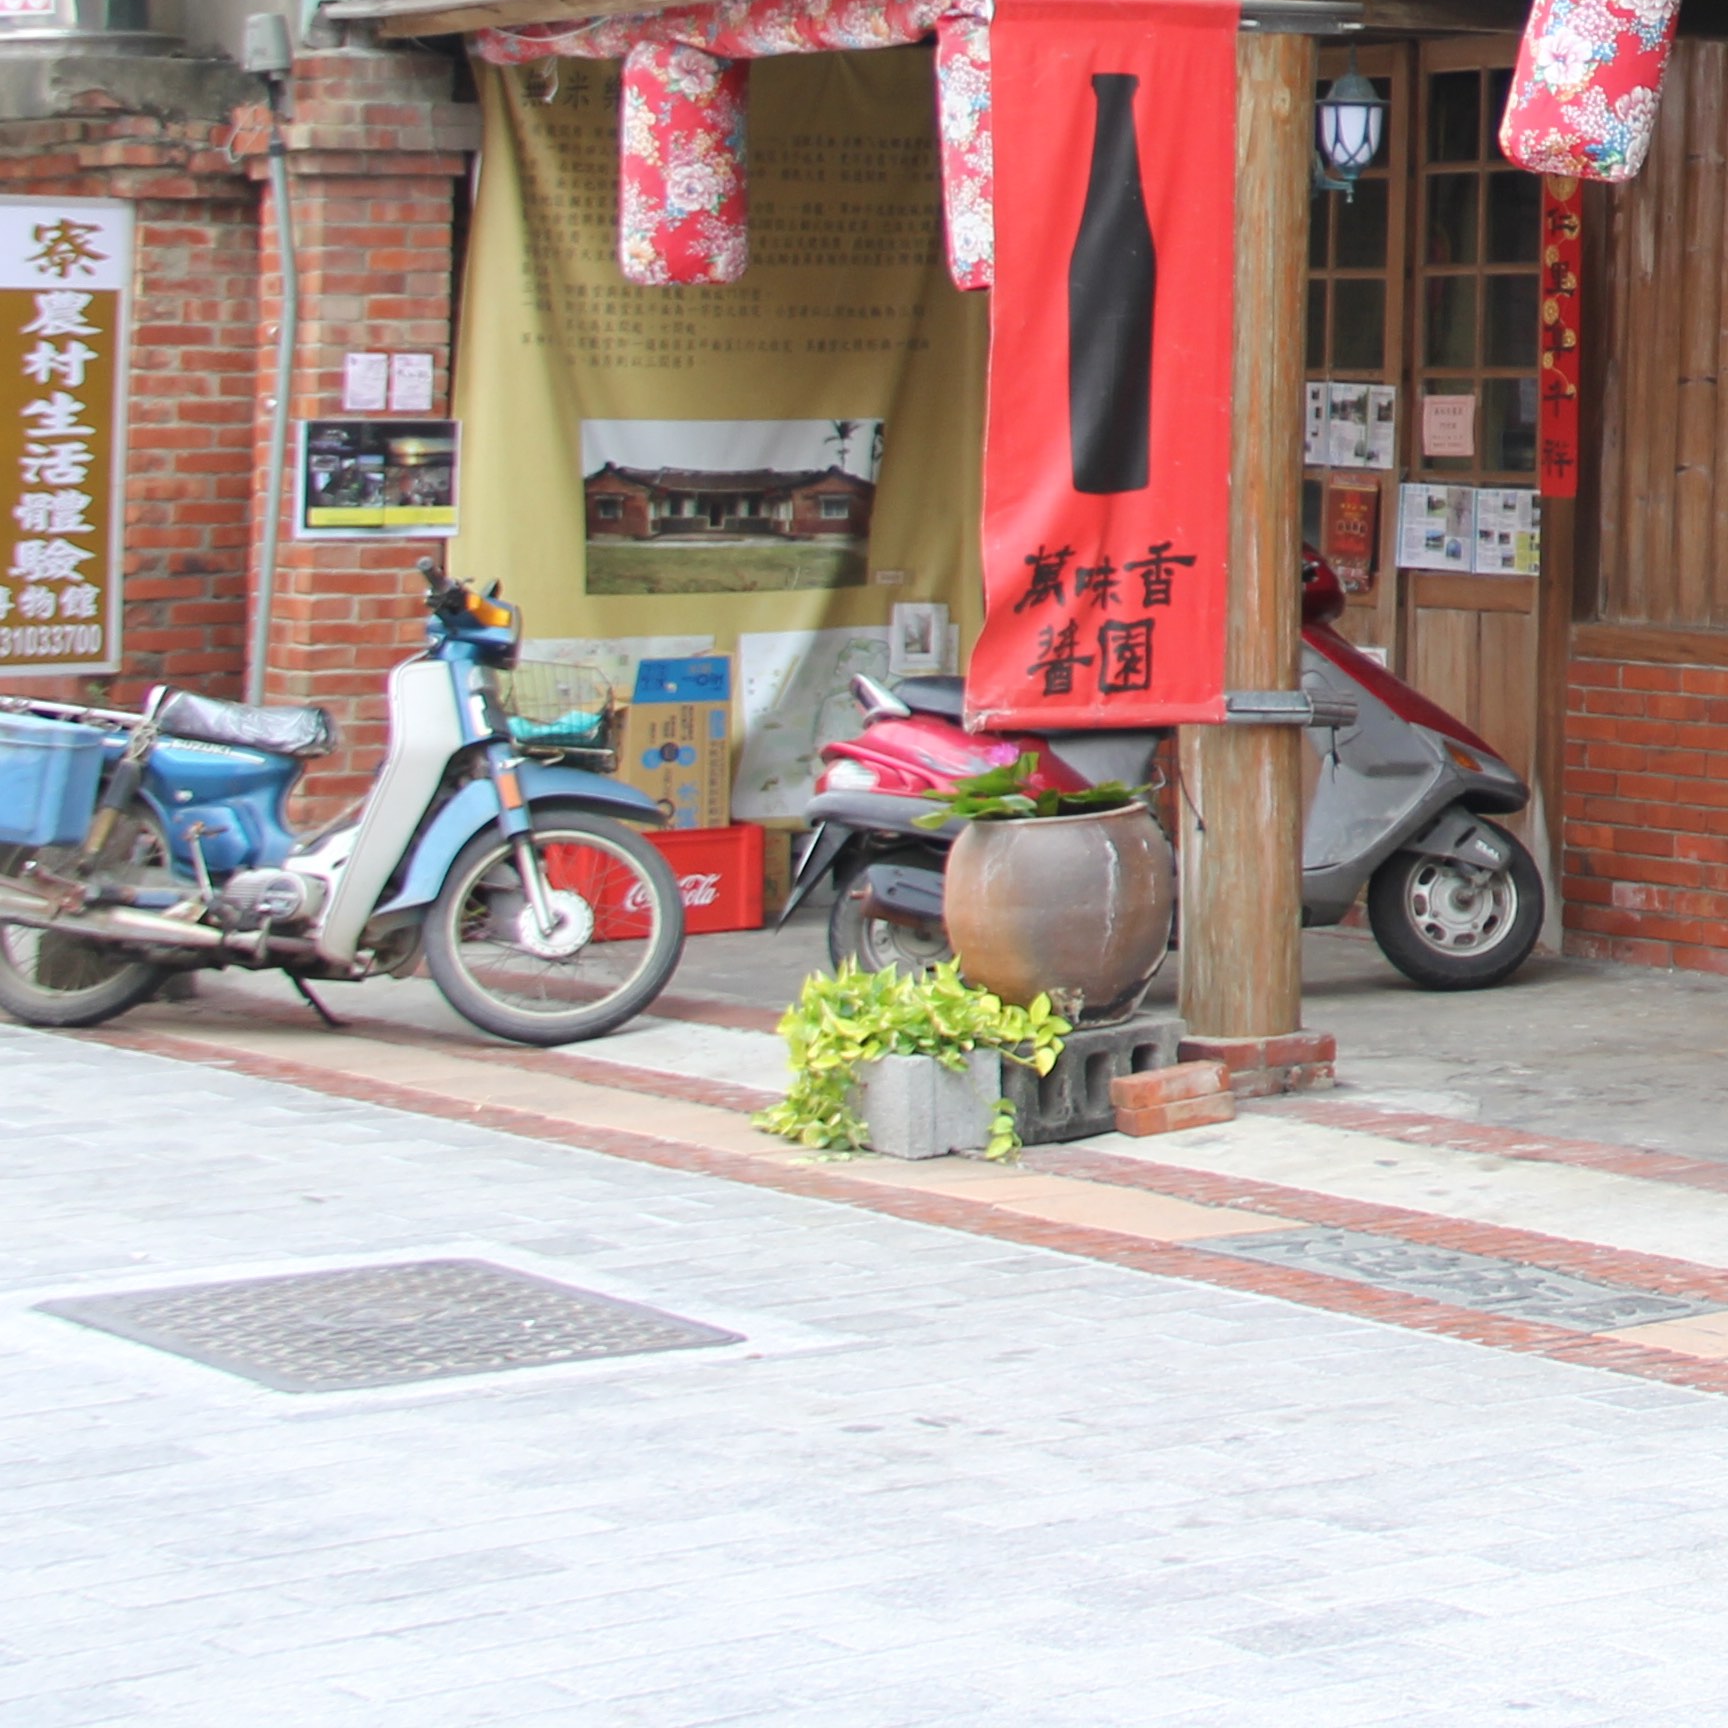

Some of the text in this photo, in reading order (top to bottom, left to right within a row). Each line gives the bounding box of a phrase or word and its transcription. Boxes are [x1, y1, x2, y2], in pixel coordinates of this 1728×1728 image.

[25, 218, 110, 278] 寮
[10, 290, 103, 582] 農村生活體驗
